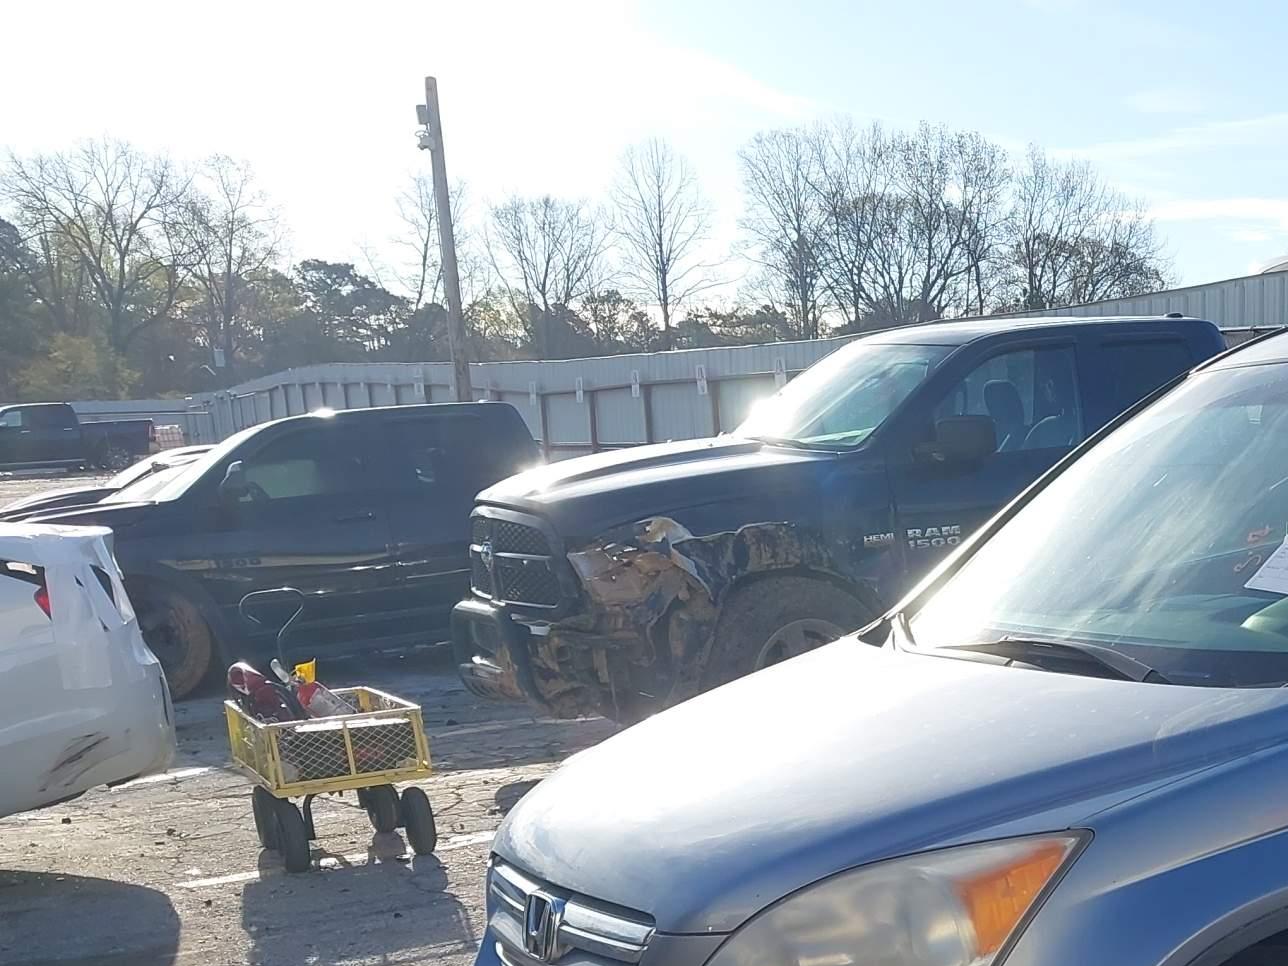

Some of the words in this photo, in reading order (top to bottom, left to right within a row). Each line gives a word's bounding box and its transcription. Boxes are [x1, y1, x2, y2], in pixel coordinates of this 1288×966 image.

[863, 532, 894, 543] HEMI
[906, 525, 961, 538] RAM
[908, 536, 961, 549] 1500
